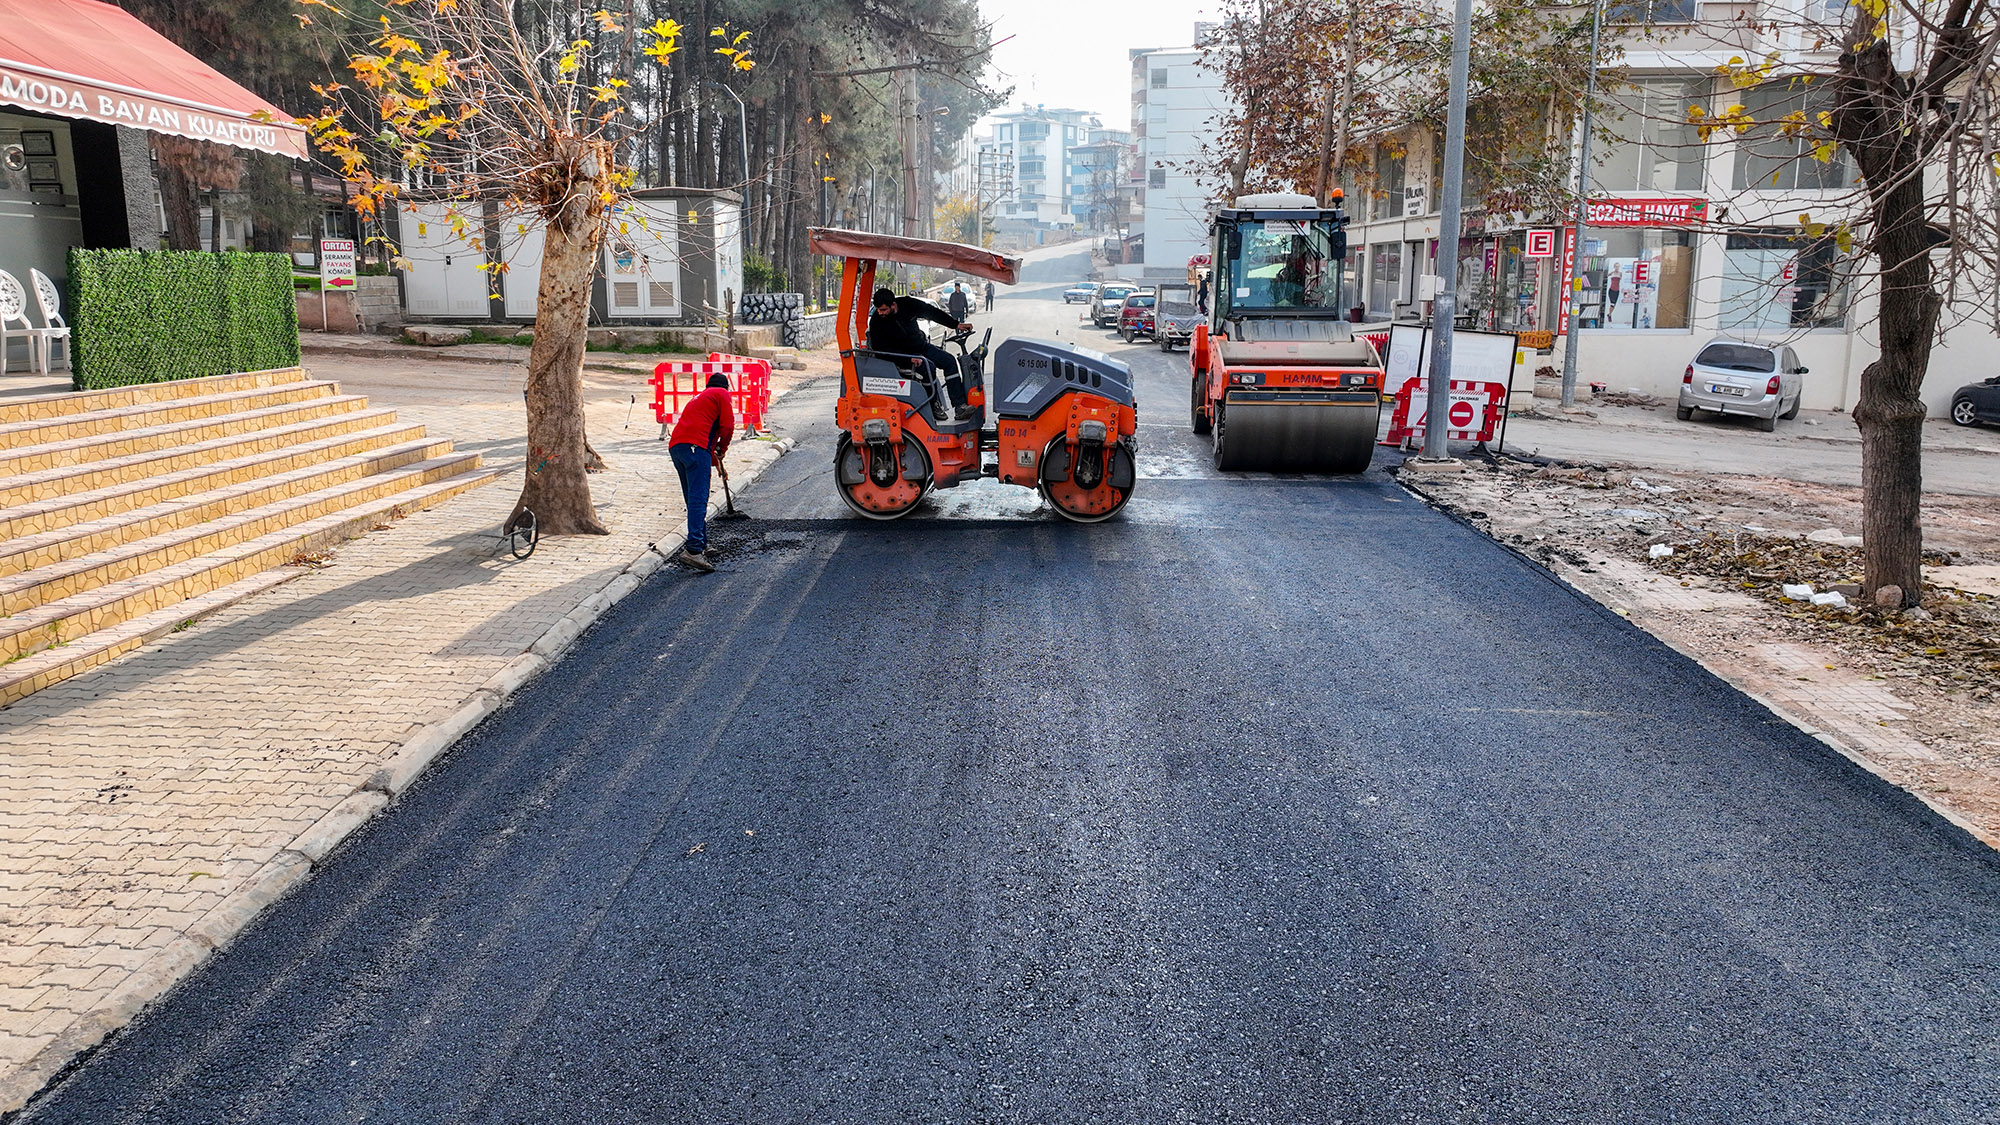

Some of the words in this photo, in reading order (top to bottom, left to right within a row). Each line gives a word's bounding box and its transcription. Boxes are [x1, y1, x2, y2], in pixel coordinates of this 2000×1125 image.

[0, 76, 88, 112] MODA
[98, 95, 180, 129] BAYAN
[1587, 204, 1640, 222] ECZANE
[1645, 204, 1689, 221] HAYAT
[1534, 235, 1547, 251] E
[1636, 264, 1647, 280] E
[1561, 234, 1575, 331] ECZANE
[1017, 359, 1026, 368] 46
[1027, 360, 1035, 368] 15
[1036, 360, 1048, 369] 004
[1283, 374, 1322, 383] HAMM
[926, 435, 950, 443] HAMM
[1004, 428, 1016, 437] HD
[1018, 429, 1027, 437] 14
